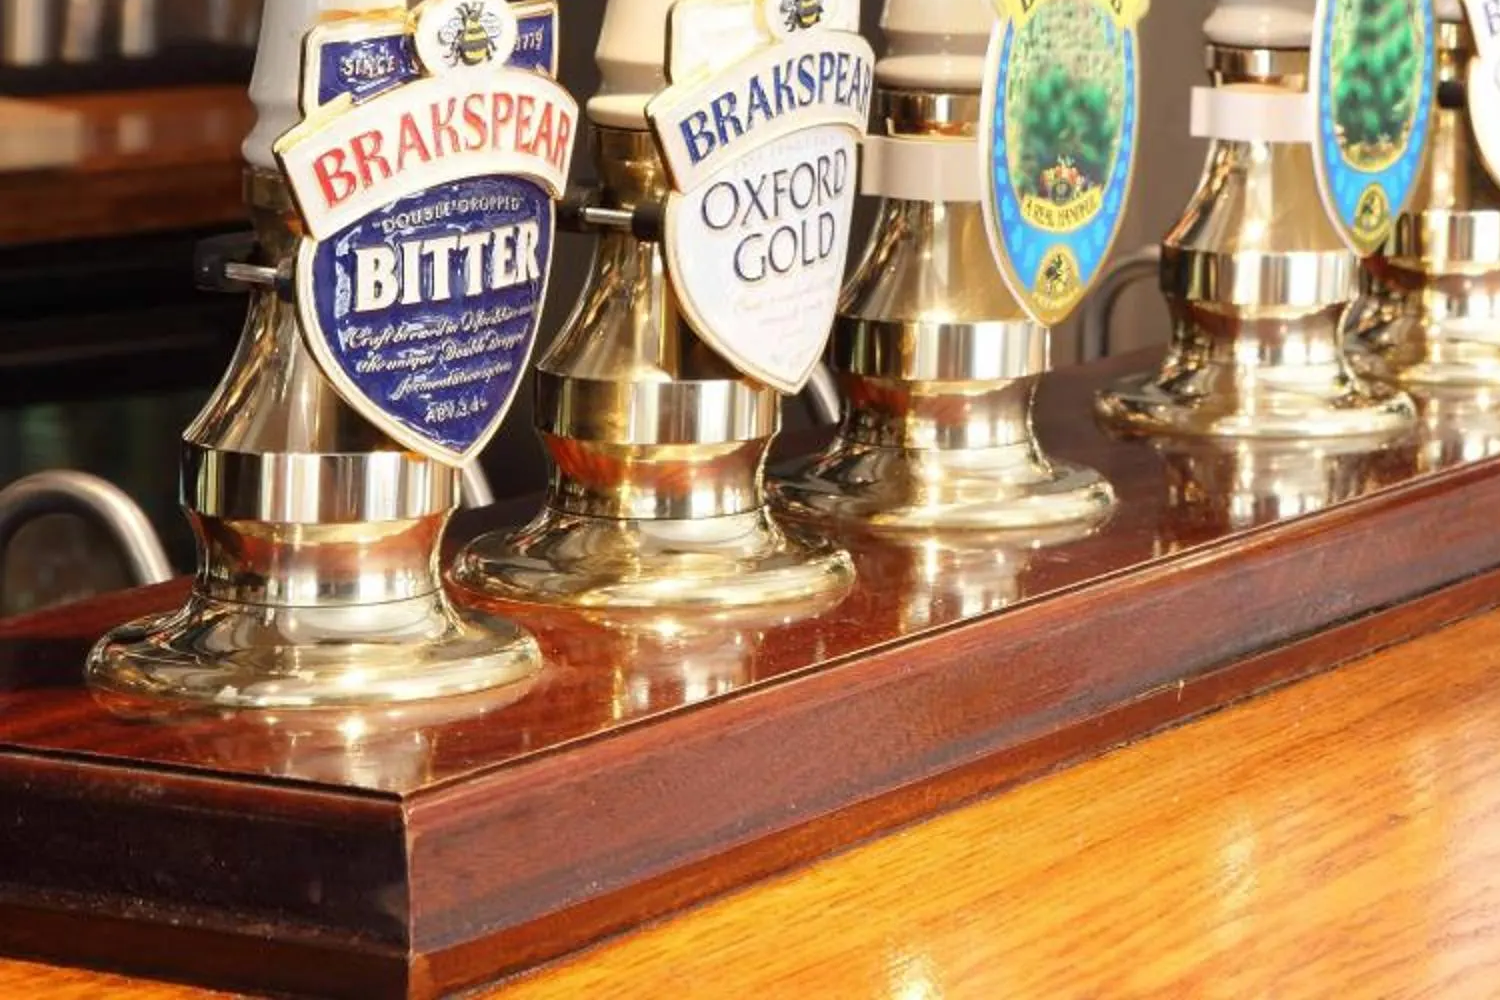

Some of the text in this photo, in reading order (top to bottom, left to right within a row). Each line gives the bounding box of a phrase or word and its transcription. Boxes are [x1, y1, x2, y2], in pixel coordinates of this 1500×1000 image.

[340, 54, 397, 79] SINCE
[678, 51, 874, 165] BRAKSPEAR
[313, 93, 570, 207] BRAKSPEAR
[701, 148, 848, 231] OXFORD
[353, 219, 541, 313] BITTER
[733, 212, 836, 284] GOLD
